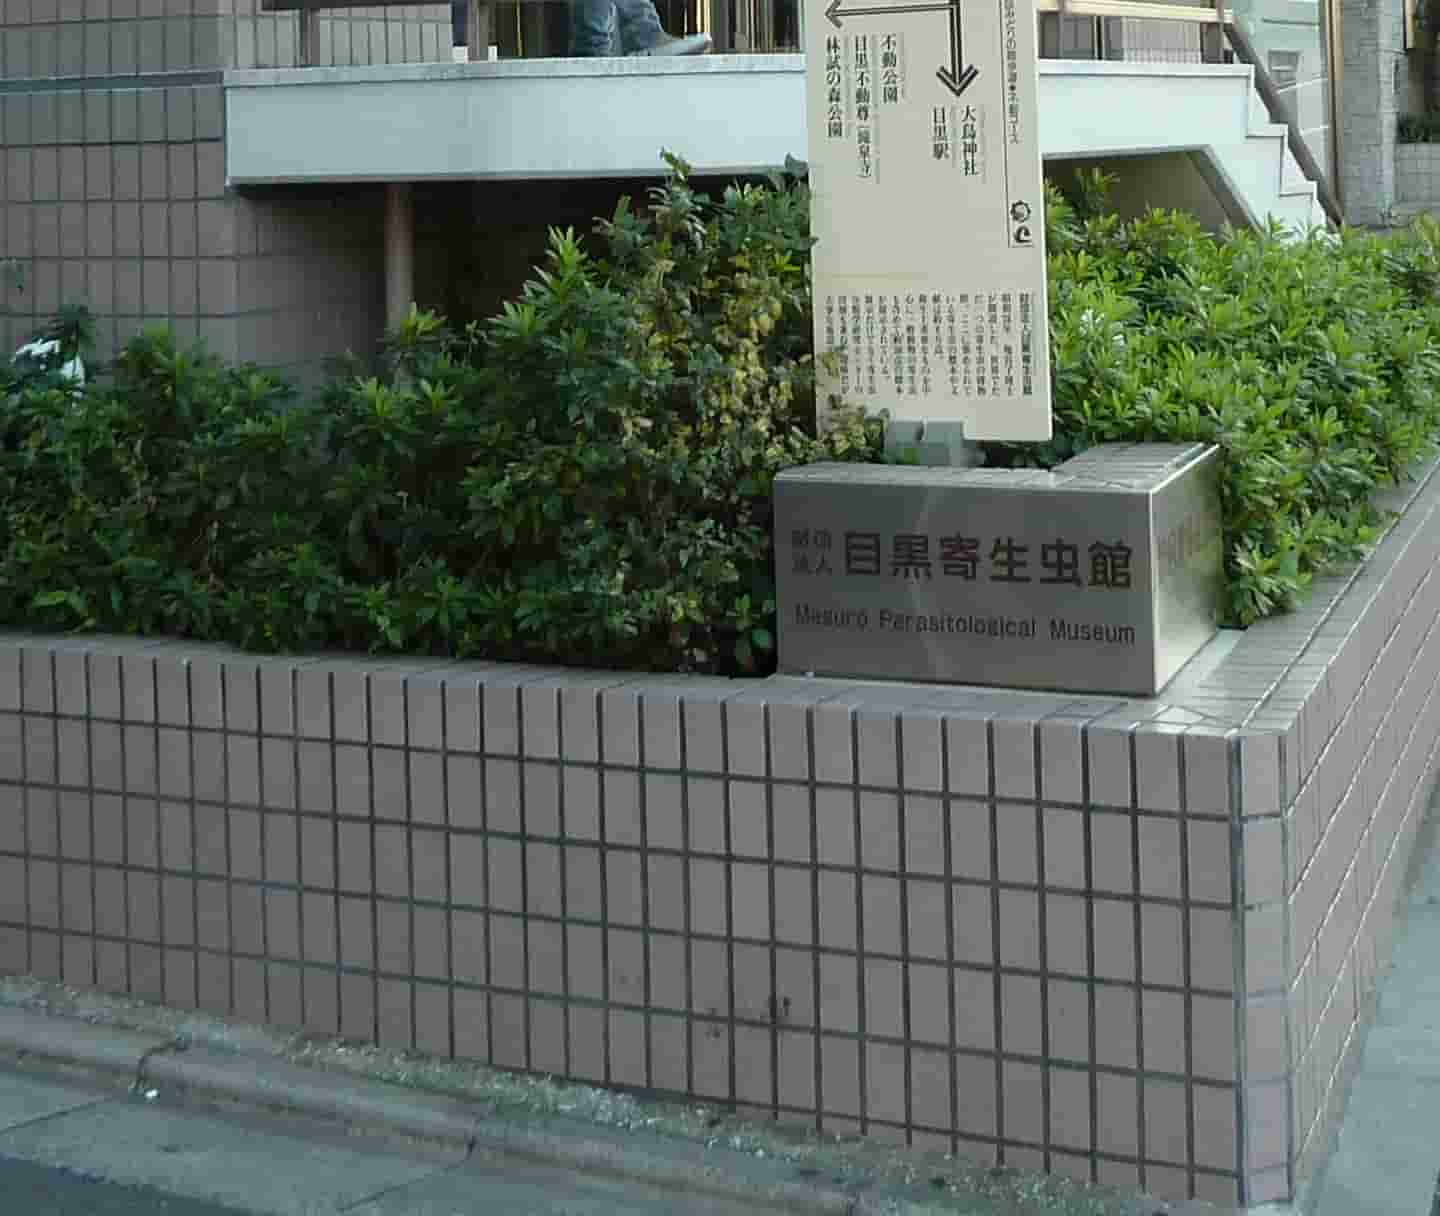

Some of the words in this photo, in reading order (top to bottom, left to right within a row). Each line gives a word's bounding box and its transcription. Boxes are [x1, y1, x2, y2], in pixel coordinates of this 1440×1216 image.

[825, 35, 843, 138] 林試の森公園
[880, 34, 898, 105] 不動公園
[933, 106, 950, 161] 目黒駅
[961, 104, 979, 177] 大鳥神社
[842, 529, 1134, 589] 目黒寄生虫館
[878, 608, 1037, 641] Parasitological
[1049, 618, 1136, 645] Museum
